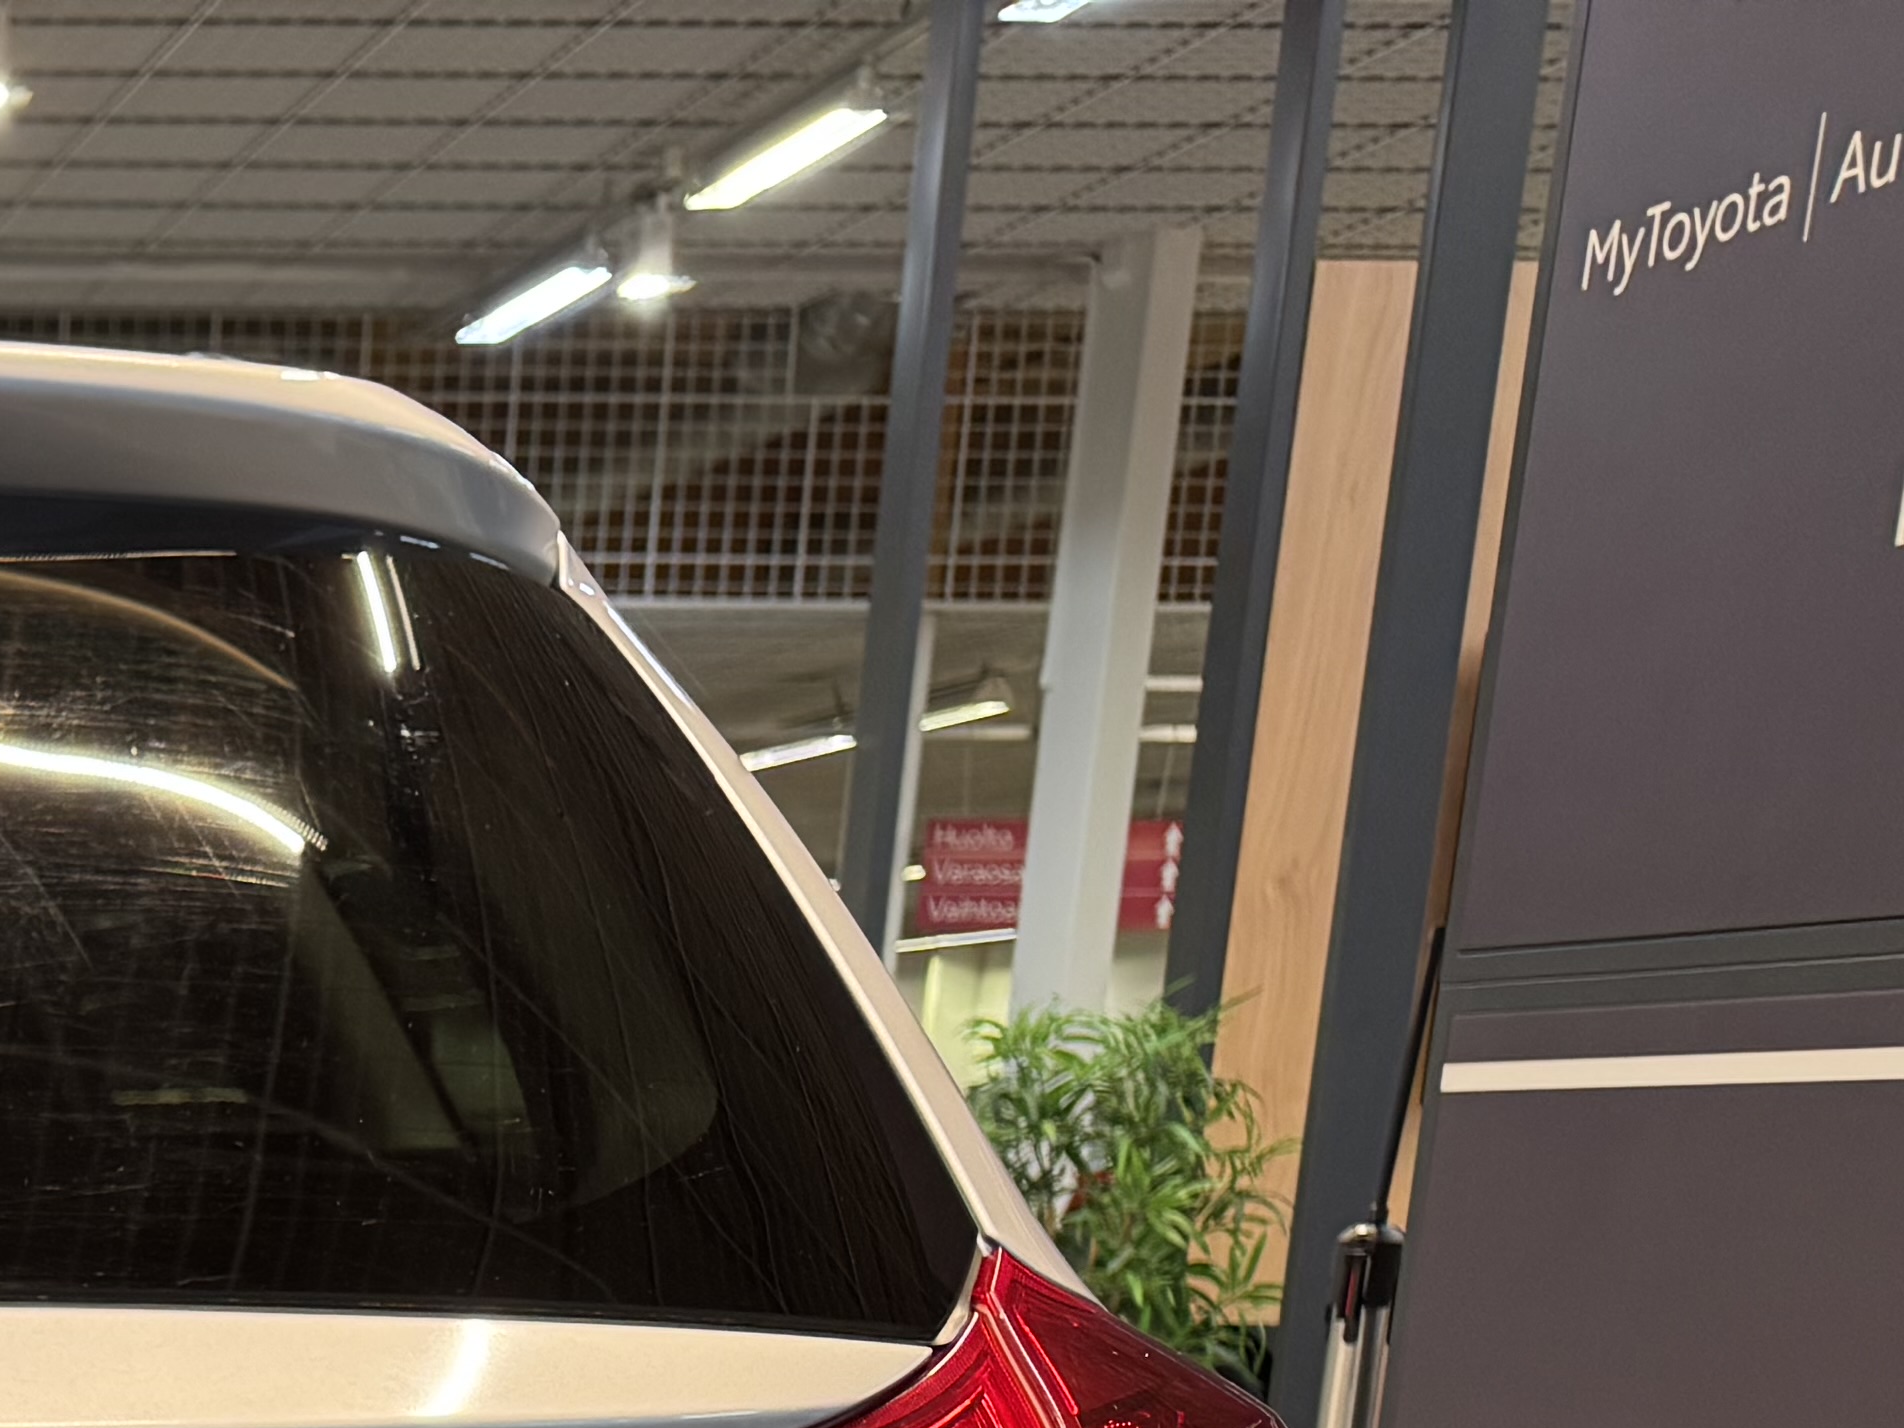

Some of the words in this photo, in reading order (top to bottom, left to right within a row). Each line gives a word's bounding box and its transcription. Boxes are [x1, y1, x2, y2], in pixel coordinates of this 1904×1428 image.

[1581, 171, 1791, 296] MyToyota
[1829, 129, 1903, 203] Au
[933, 823, 1014, 852] Huolto
